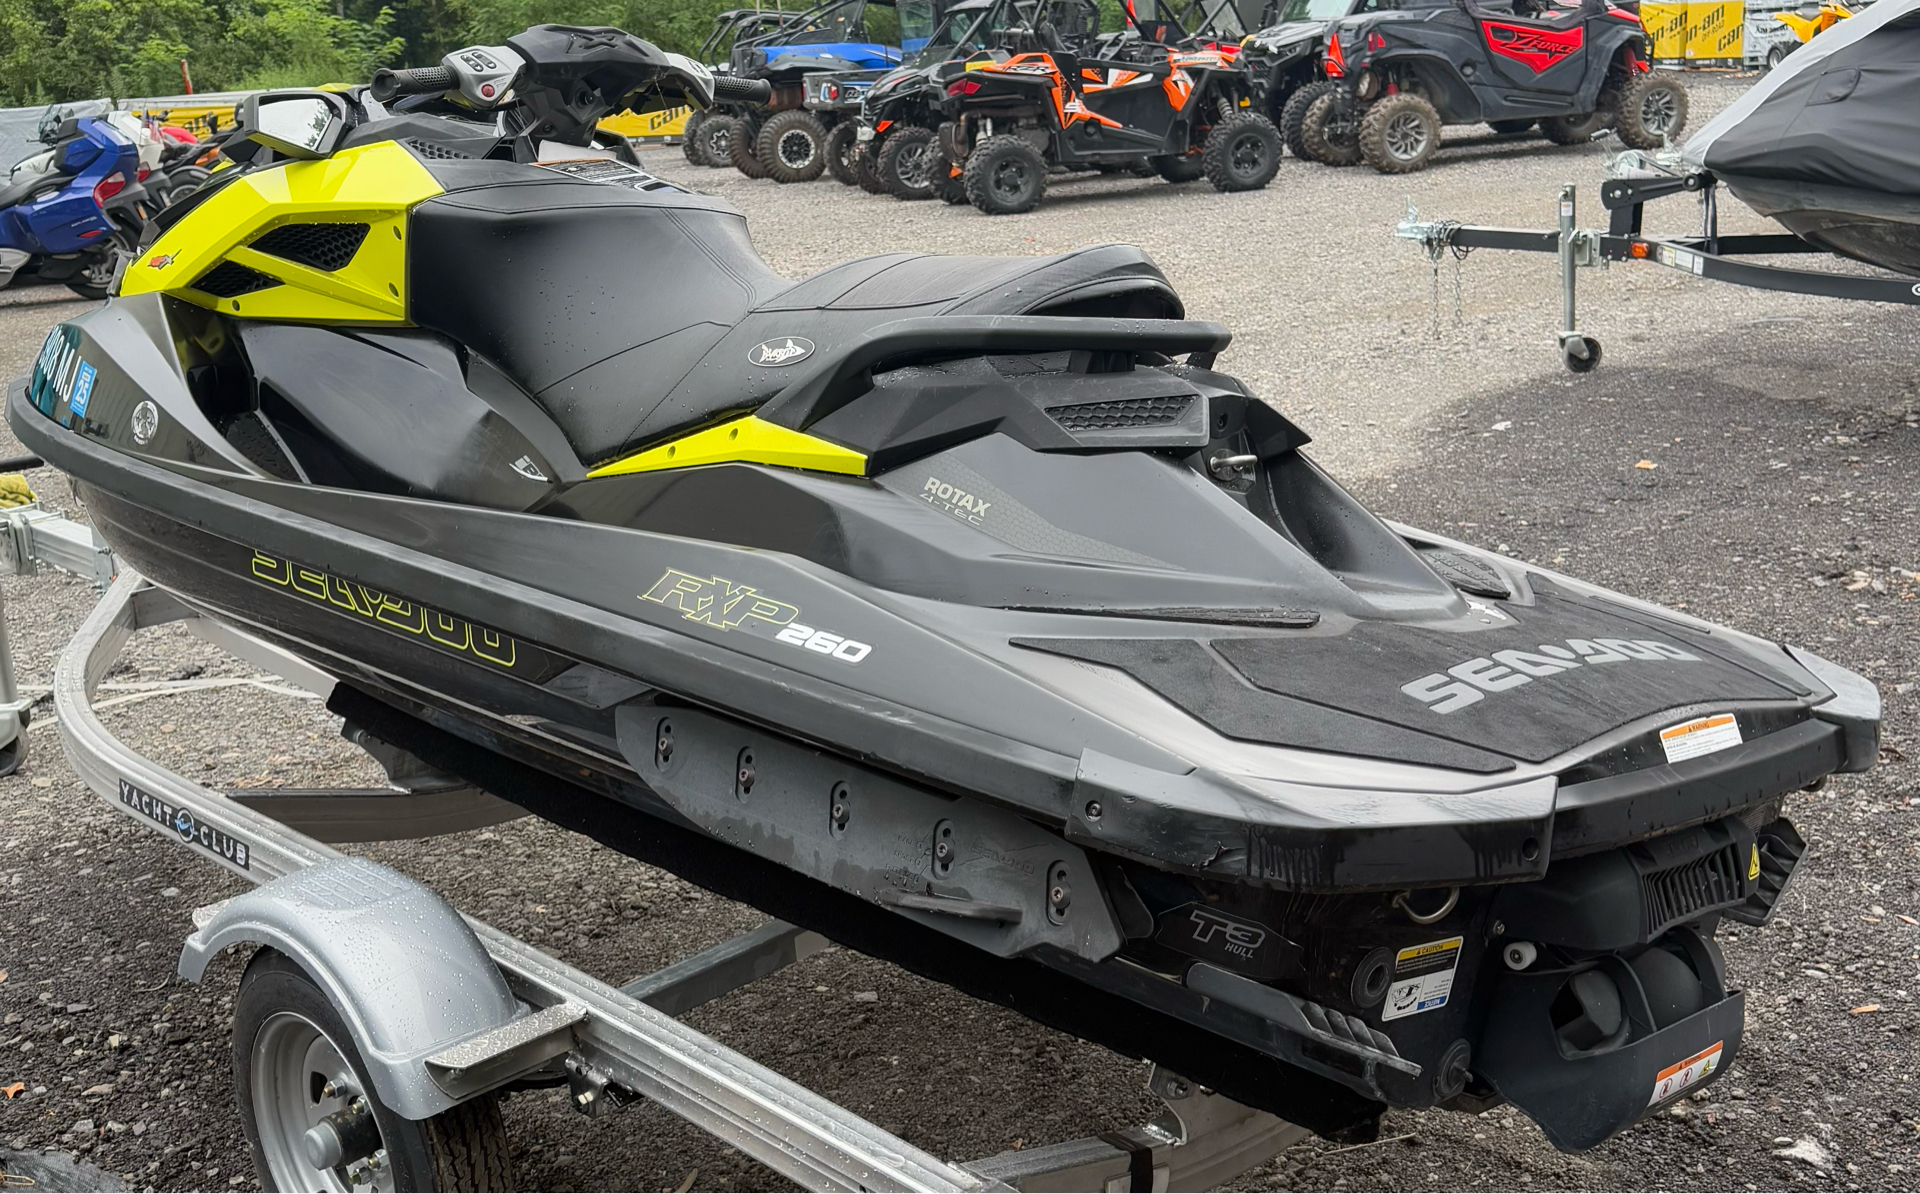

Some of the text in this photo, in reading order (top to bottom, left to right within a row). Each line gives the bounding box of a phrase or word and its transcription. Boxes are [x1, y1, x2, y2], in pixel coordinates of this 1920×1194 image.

[53, 342, 81, 402] MJ
[919, 494, 983, 525] 4-TEC
[923, 477, 991, 517] ROTAX
[641, 569, 872, 663] RXP 260
[121, 781, 246, 866] YACHT CLUB
[1190, 909, 1265, 948] T3
[1224, 942, 1254, 958] HULL
